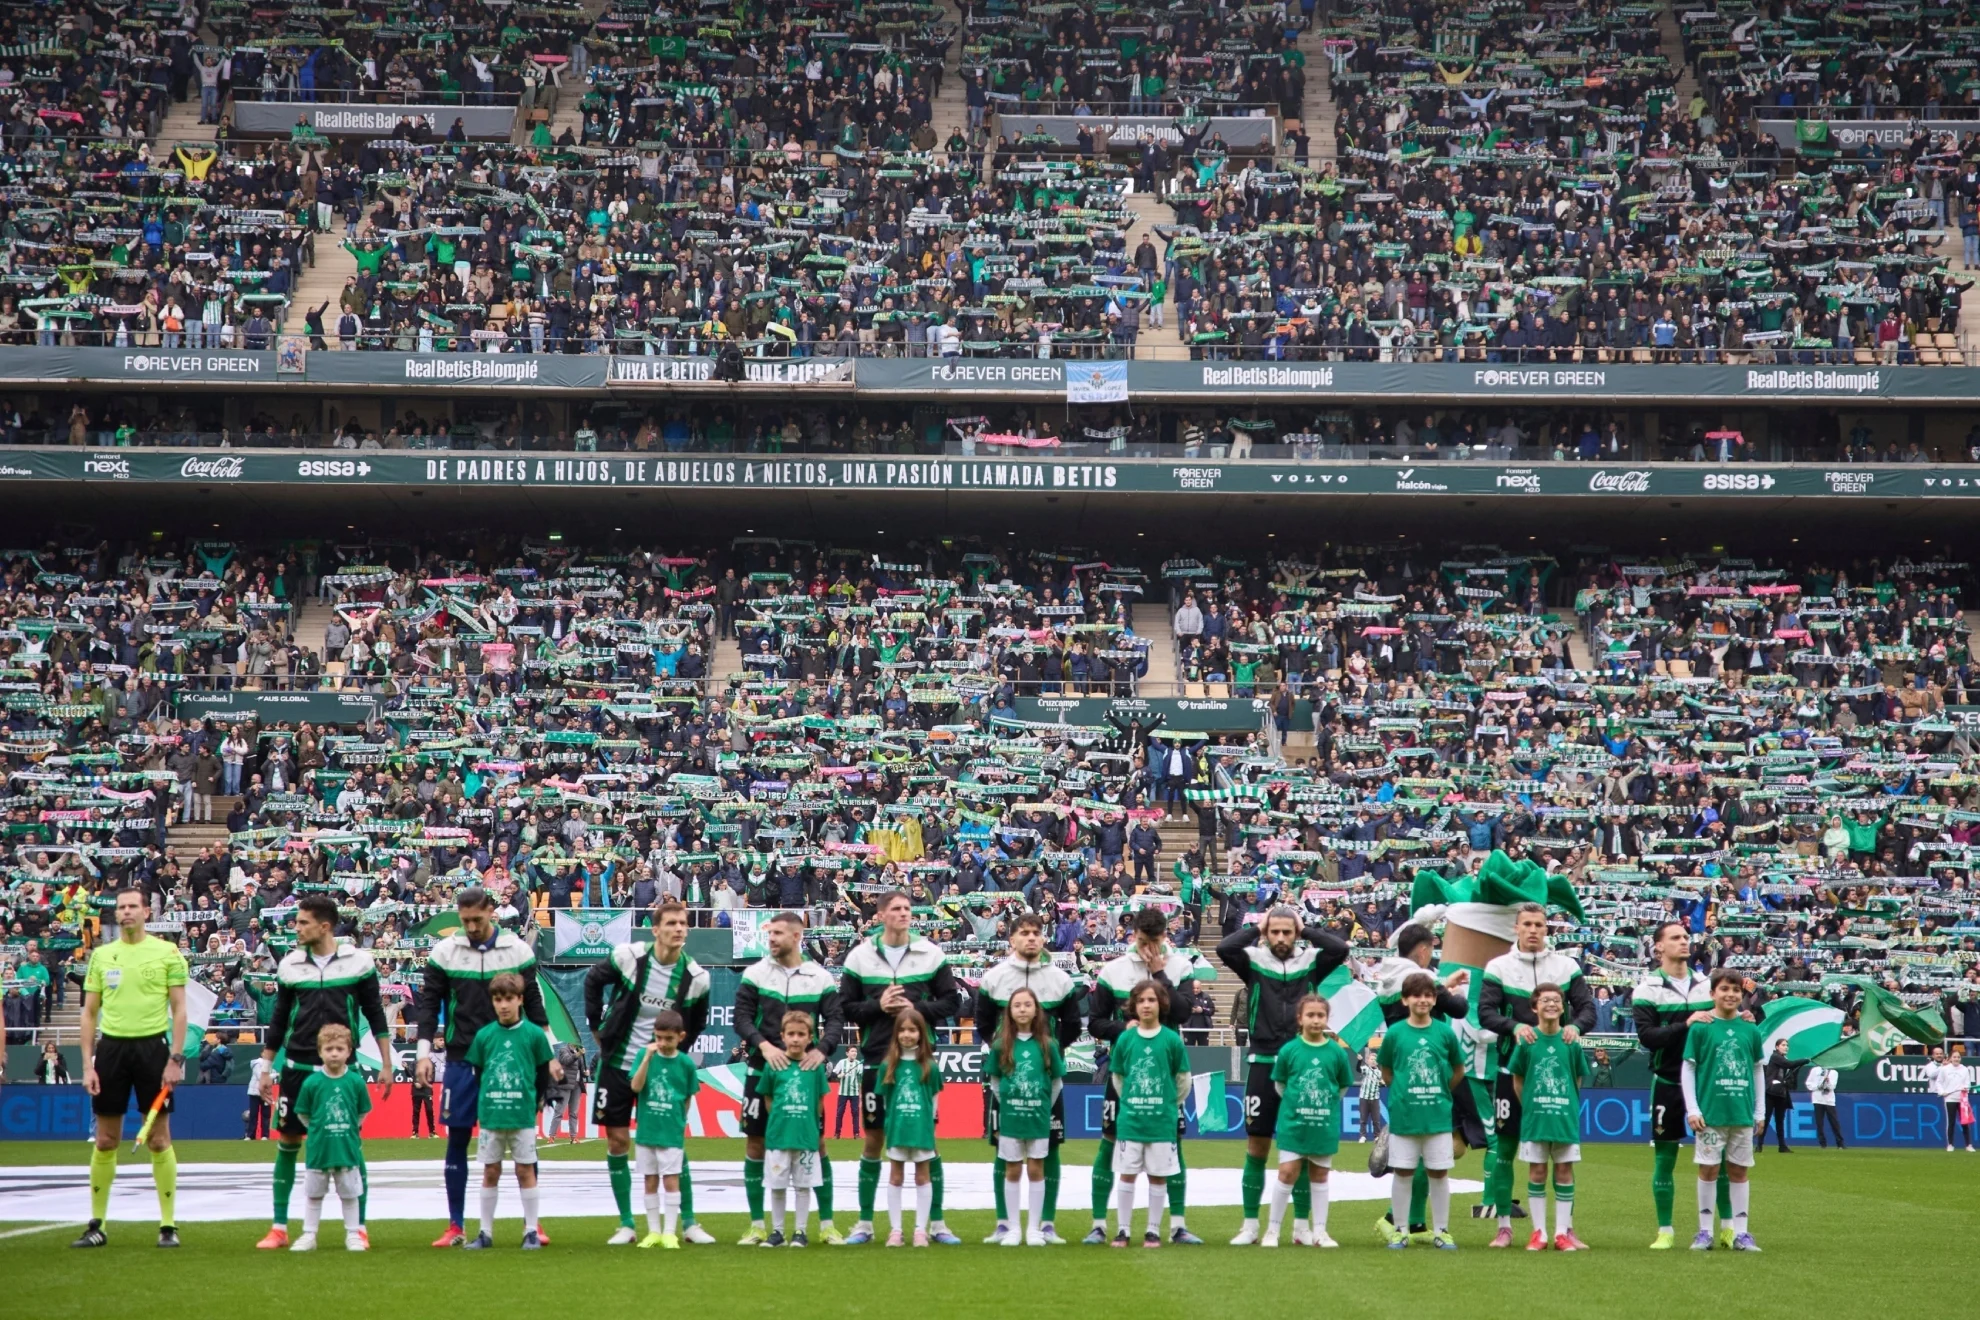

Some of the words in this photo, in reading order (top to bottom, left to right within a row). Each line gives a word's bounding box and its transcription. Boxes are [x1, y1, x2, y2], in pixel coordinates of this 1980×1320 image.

[316, 110, 342, 128] Real
[344, 112, 374, 128] Betis
[1832, 128, 1903, 144] FOREVER
[124, 355, 202, 372] FOREVER
[207, 357, 259, 372] GREEN
[405, 359, 436, 378] Real
[436, 360, 471, 378] Betis
[472, 359, 538, 381] Balompié
[617, 362, 648, 381] VIVA
[652, 362, 668, 380] EL
[671, 362, 709, 380] BETIS
[931, 365, 1006, 381] FOREVER
[1011, 366, 1061, 382] GREEN
[1203, 366, 1233, 385] Real
[1233, 367, 1268, 385] Betis
[1268, 366, 1333, 388] Balompié
[1474, 370, 1550, 386] FOREVER
[1554, 370, 1606, 386] GREEN
[1748, 370, 1778, 389] Real
[1779, 371, 1814, 389] Betis
[1814, 370, 1880, 393] Balompié
[84, 460, 130, 474] next
[181, 456, 246, 478] Coca-Cola
[298, 460, 355, 477] asisa
[426, 459, 447, 480] DE
[456, 459, 527, 481] PADRES
[535, 460, 546, 481] A
[554, 460, 617, 484] HIJOS,
[625, 461, 646, 481] DE
[654, 461, 735, 482] ABUELOS
[744, 462, 754, 482] A
[763, 462, 834, 487] NIETOS,
[842, 463, 878, 484] UNA
[886, 460, 953, 485] PASIÓN
[961, 464, 1045, 486] LLAMADA
[1053, 466, 1117, 487] BETIS
[1173, 467, 1222, 479] FOREVER
[1180, 478, 1214, 488] GREEN
[1271, 474, 1348, 484] VOLVO
[1397, 479, 1431, 490] Halcón
[1496, 475, 1541, 489] next
[1589, 470, 1653, 492] Coca-Cola
[1703, 474, 1760, 490] asisa
[1825, 472, 1874, 484] FOREVER
[1833, 482, 1867, 492] GREEN
[192, 694, 228, 702] CaixaBank
[338, 694, 377, 702] REVEL
[1037, 698, 1080, 709] Cruzcampo
[1112, 699, 1151, 707] REVEL
[1190, 701, 1228, 710] trainline
[810, 857, 825, 868] Real
[825, 858, 842, 869] Betis
[576, 947, 610, 955] OLIVARES
[597, 1088, 608, 1109] 3
[865, 1092, 877, 1113] 6
[1244, 1096, 1261, 1117] 12
[742, 1098, 760, 1120] 24
[1103, 1100, 1116, 1122] 21
[1496, 1098, 1511, 1120] 18
[1655, 1105, 1666, 1126] 7
